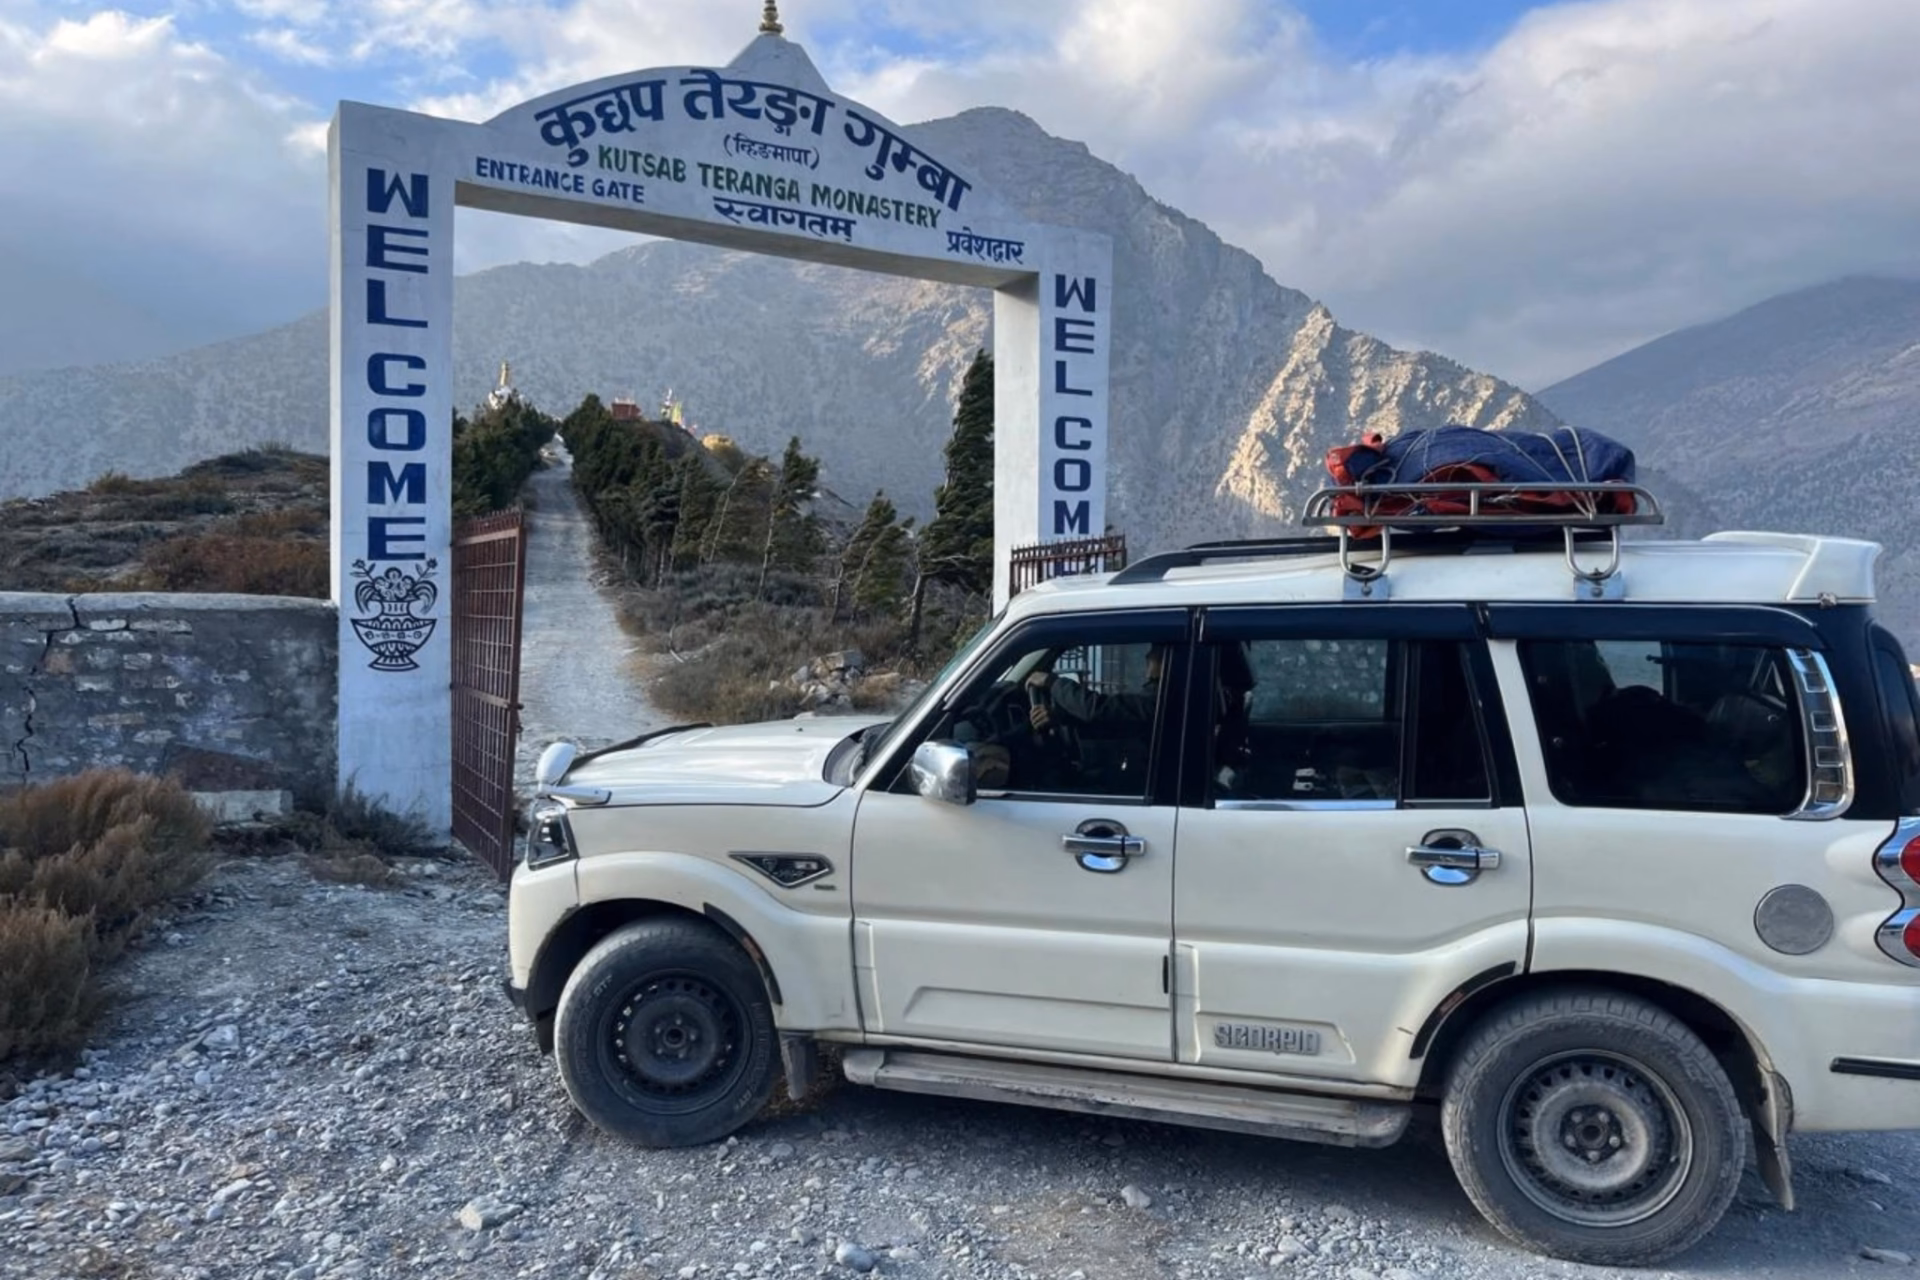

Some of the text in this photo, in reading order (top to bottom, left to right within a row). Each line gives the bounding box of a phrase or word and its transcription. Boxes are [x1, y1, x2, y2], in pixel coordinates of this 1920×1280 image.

[475, 156, 645, 204] ENTRANCE GATE
[598, 144, 942, 229] KUTSAB TERANGA MONASTERY
[843, 108, 972, 212] गुम्बा
[946, 226, 1025, 265] प्रवेशद्वार
[366, 167, 429, 561] WELCOME
[1053, 273, 1096, 576] WELCOM
